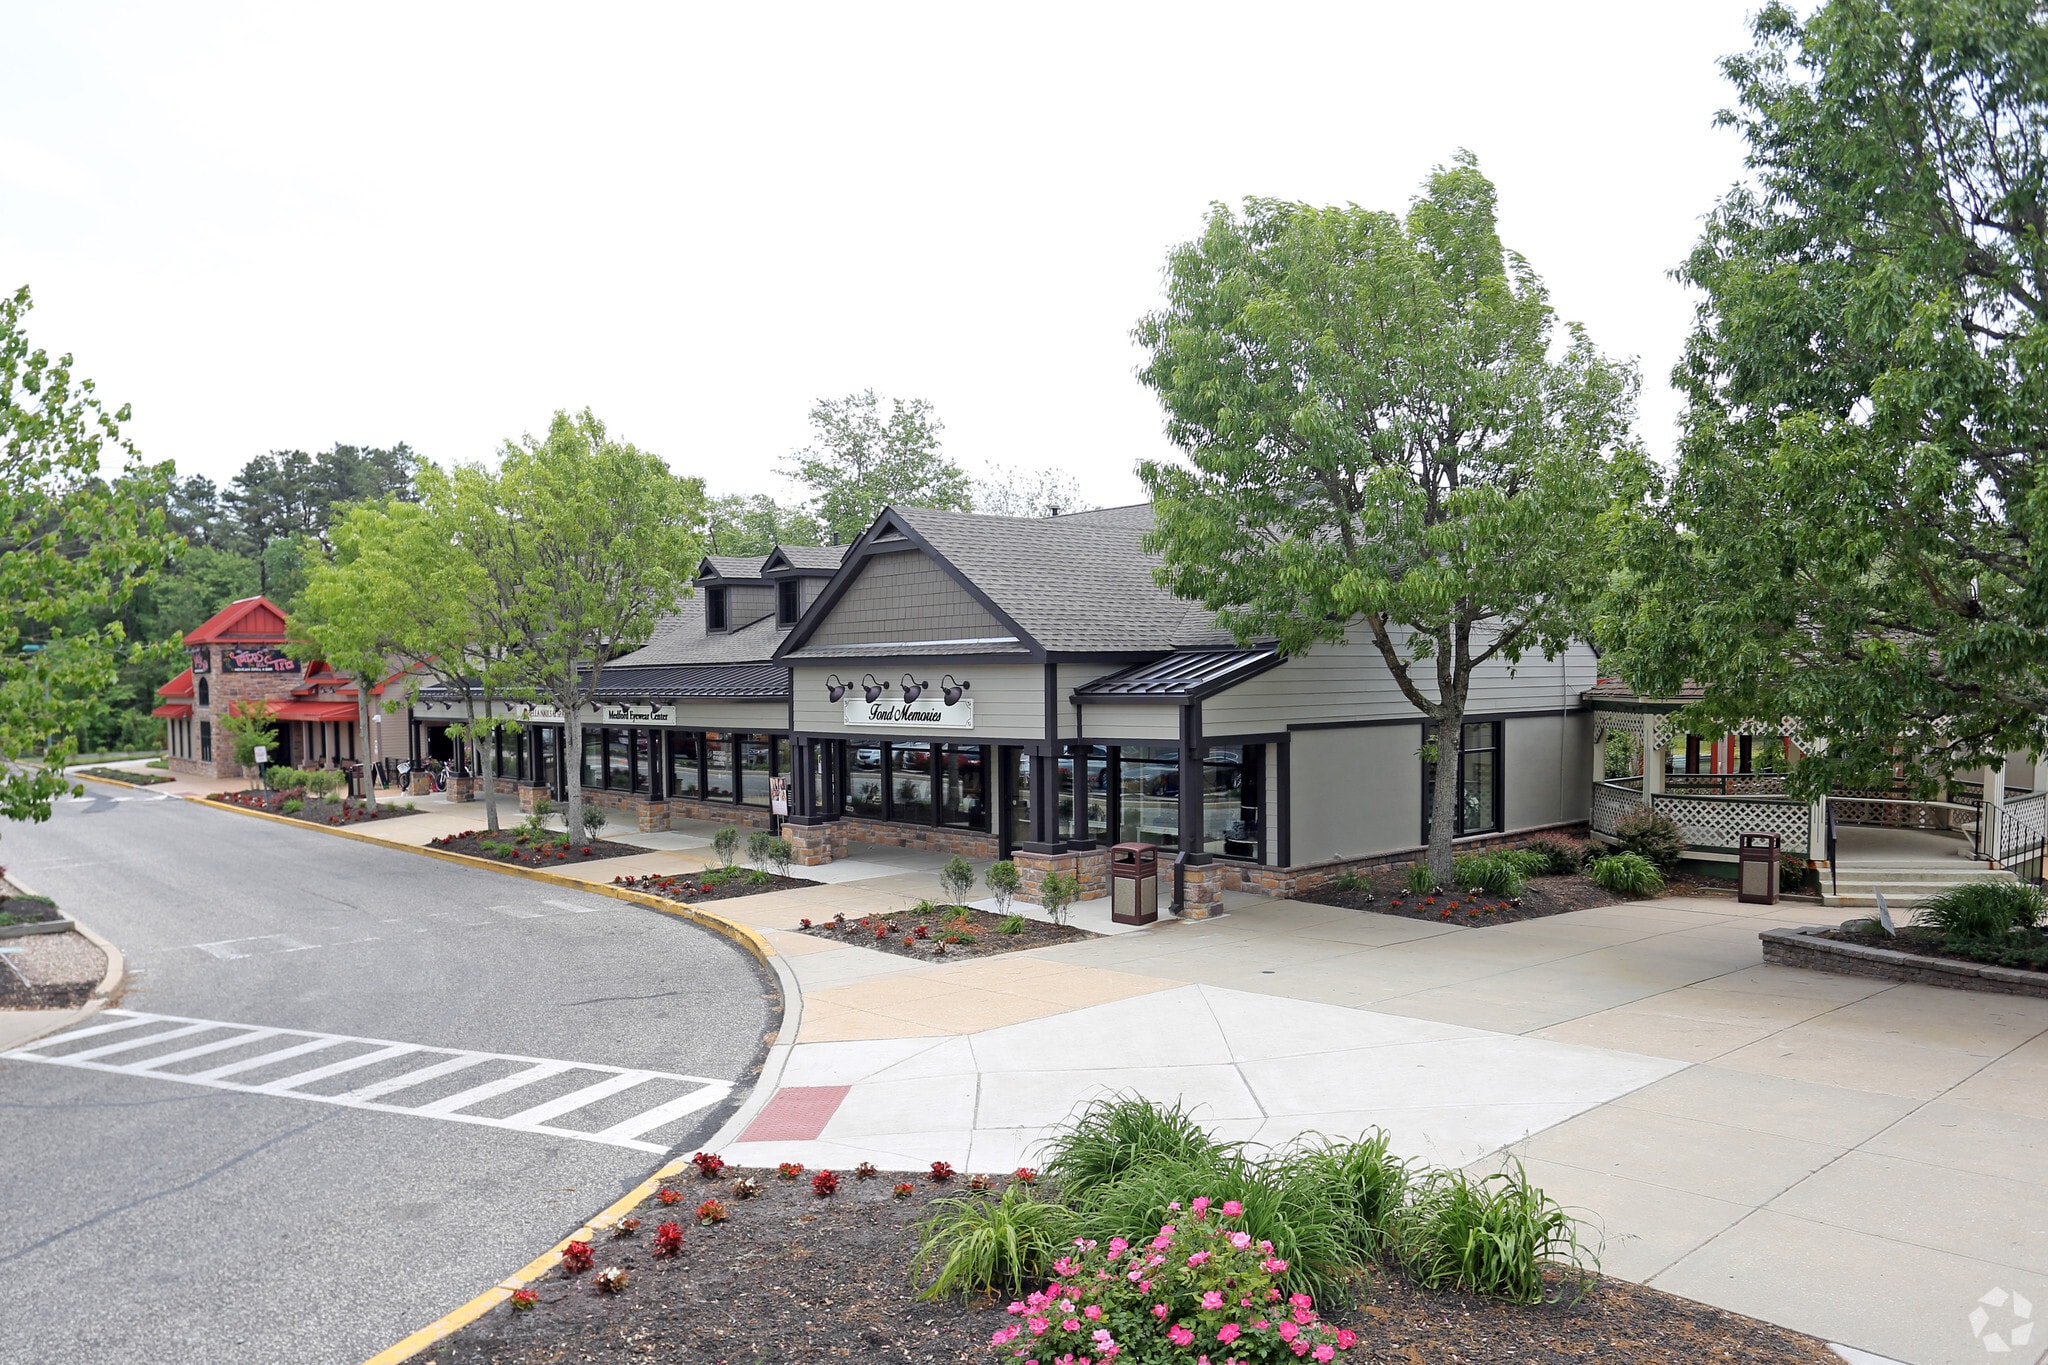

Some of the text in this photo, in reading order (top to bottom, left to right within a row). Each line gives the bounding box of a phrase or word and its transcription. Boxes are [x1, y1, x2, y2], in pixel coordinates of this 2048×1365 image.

[608, 710, 668, 723] Medford Eyewear Center
[868, 703, 942, 722] Fond Memories
